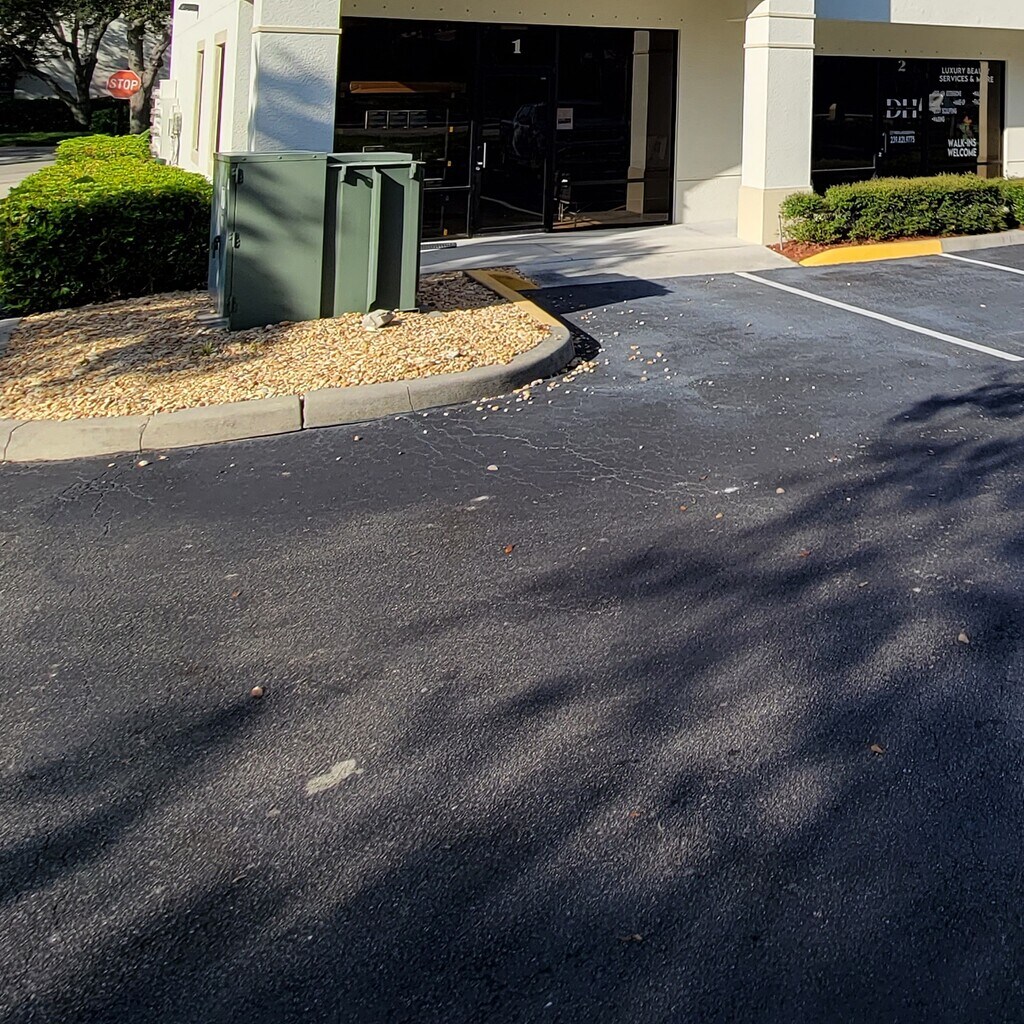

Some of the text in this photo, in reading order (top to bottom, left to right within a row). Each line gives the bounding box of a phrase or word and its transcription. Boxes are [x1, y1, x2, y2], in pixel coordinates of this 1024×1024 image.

[512, 38, 521, 54] 1
[898, 60, 906, 72] 2
[109, 78, 138, 90] STOP
[939, 75, 969, 83] SERVICES
[947, 138, 977, 148] WALK-INS
[947, 148, 977, 157] WELCOME
